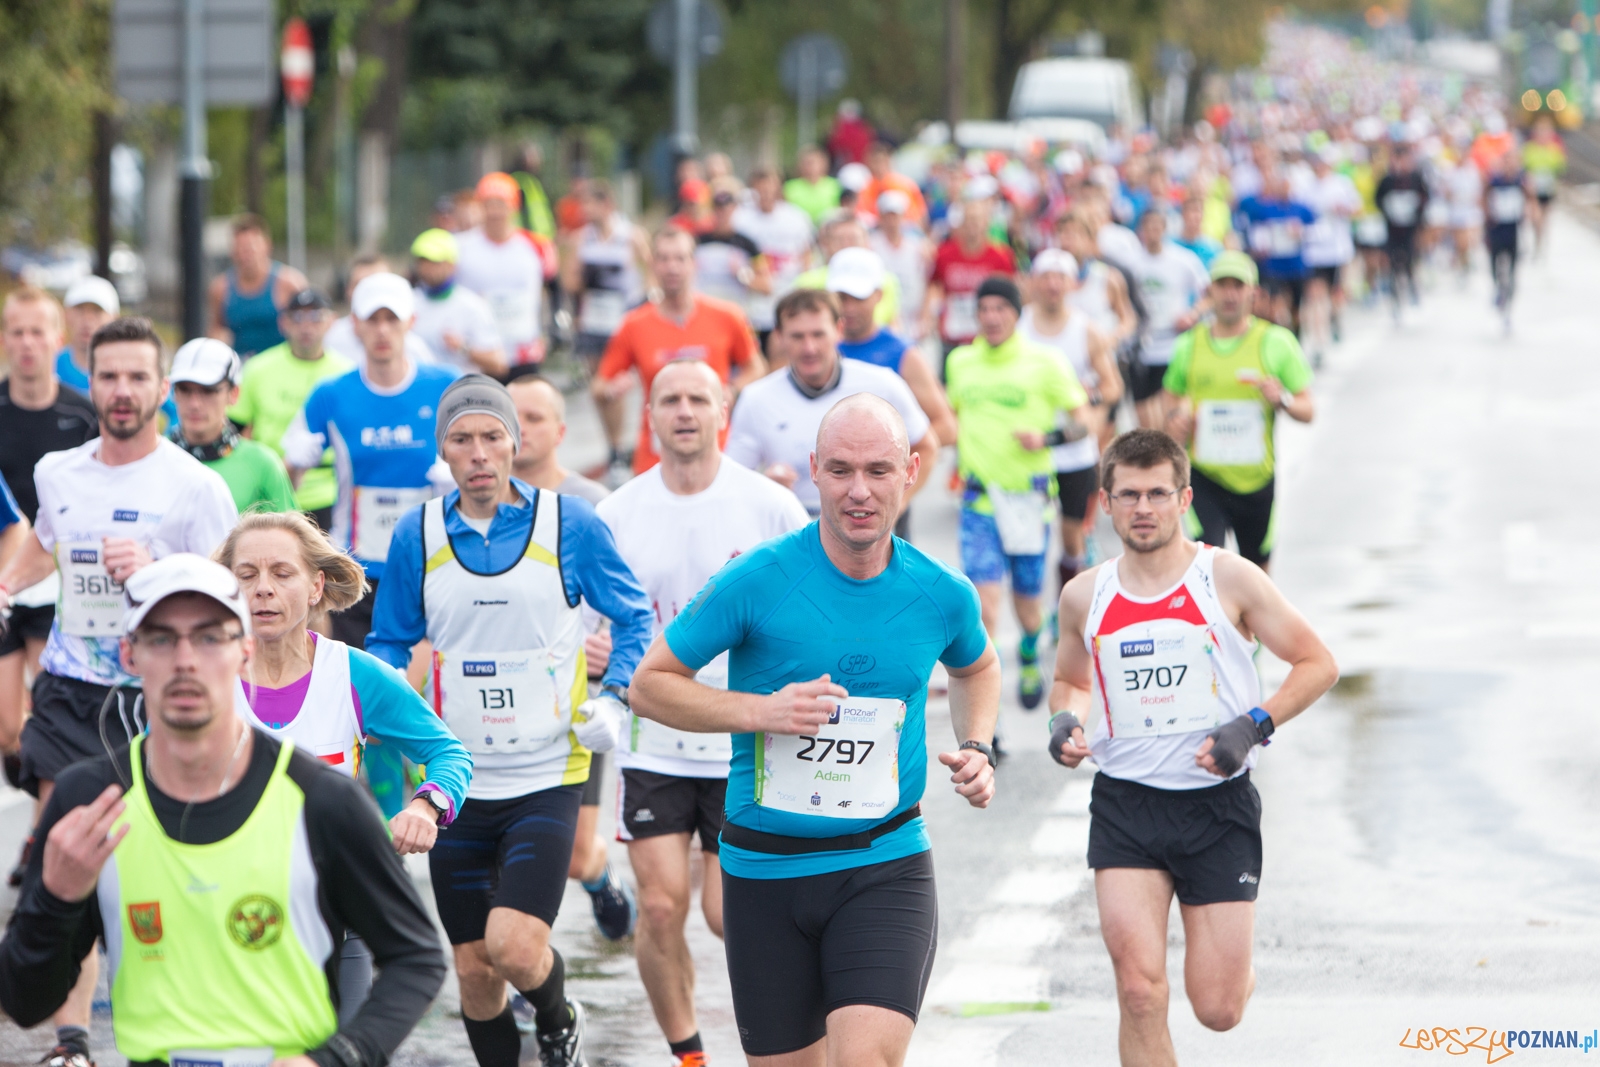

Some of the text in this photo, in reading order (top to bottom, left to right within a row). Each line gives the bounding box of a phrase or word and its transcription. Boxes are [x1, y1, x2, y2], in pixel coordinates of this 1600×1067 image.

[845, 654, 869, 672] SPP
[845, 678, 880, 690] Team
[1124, 664, 1188, 691] 3707
[479, 688, 514, 709] 131
[1140, 694, 1175, 705] Robert
[843, 715, 876, 723] maraton
[797, 736, 875, 764] 2797
[814, 770, 851, 782] Adam
